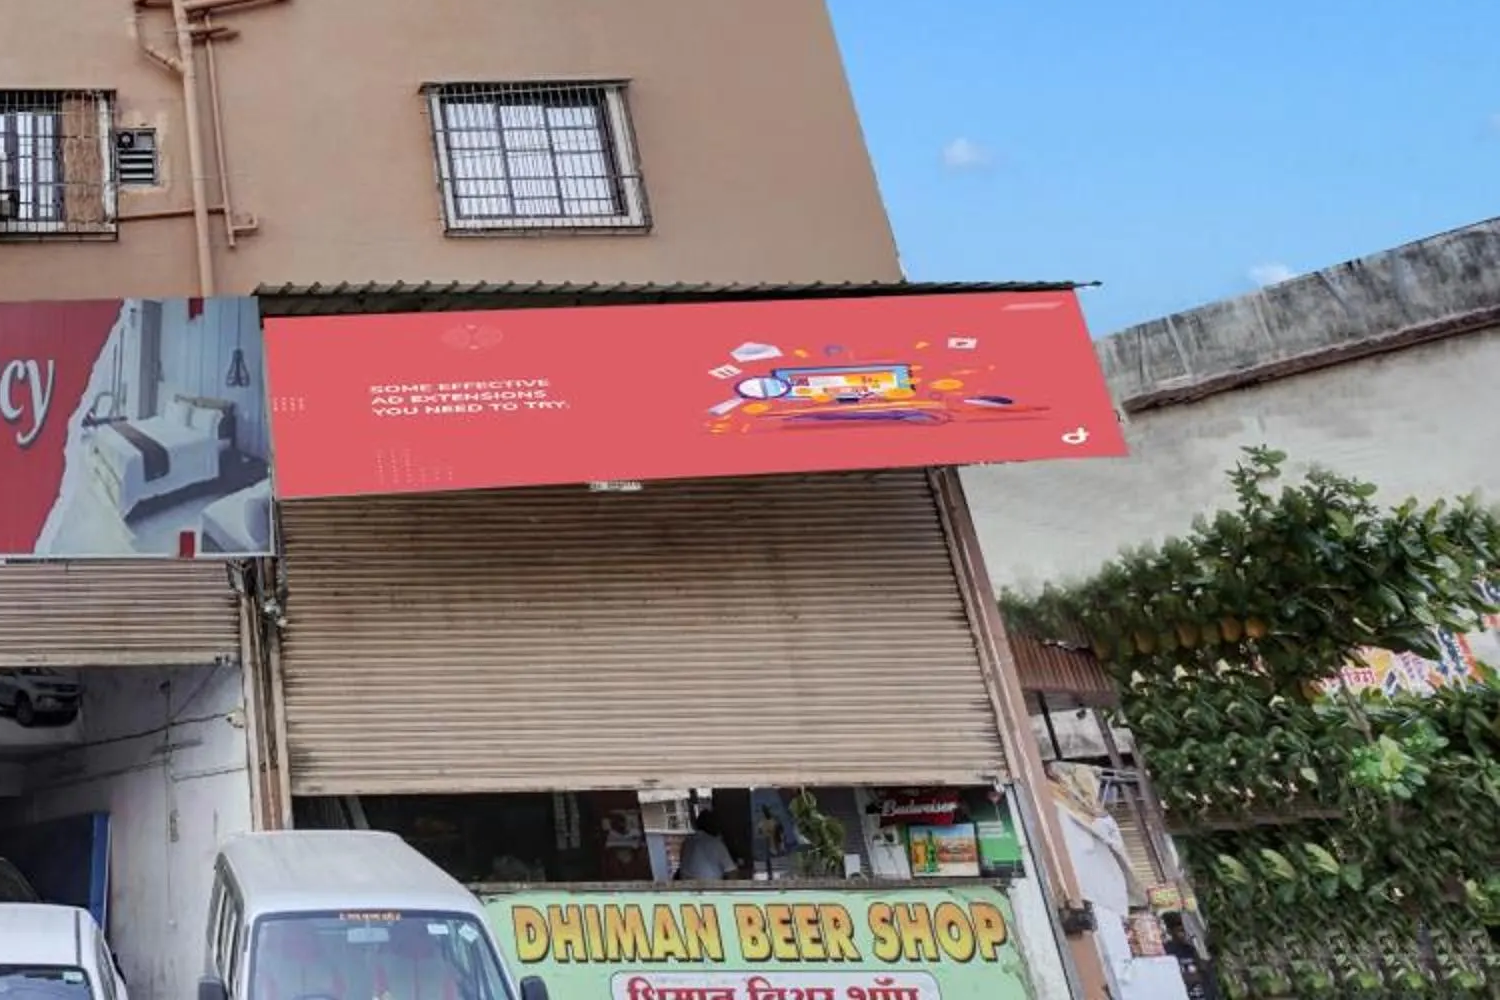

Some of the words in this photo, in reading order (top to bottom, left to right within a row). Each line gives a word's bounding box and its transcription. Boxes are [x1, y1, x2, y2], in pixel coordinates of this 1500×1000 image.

[370, 383, 433, 394] SOME
[437, 377, 551, 392] EFFECTIVE
[410, 389, 548, 404] EXTENSIONS
[371, 406, 419, 417] YOU
[424, 403, 484, 414] NEED
[489, 401, 518, 412] TO
[512, 903, 724, 963] DHIMAN
[733, 903, 862, 963] BEER
[867, 901, 1007, 964] SHOP
